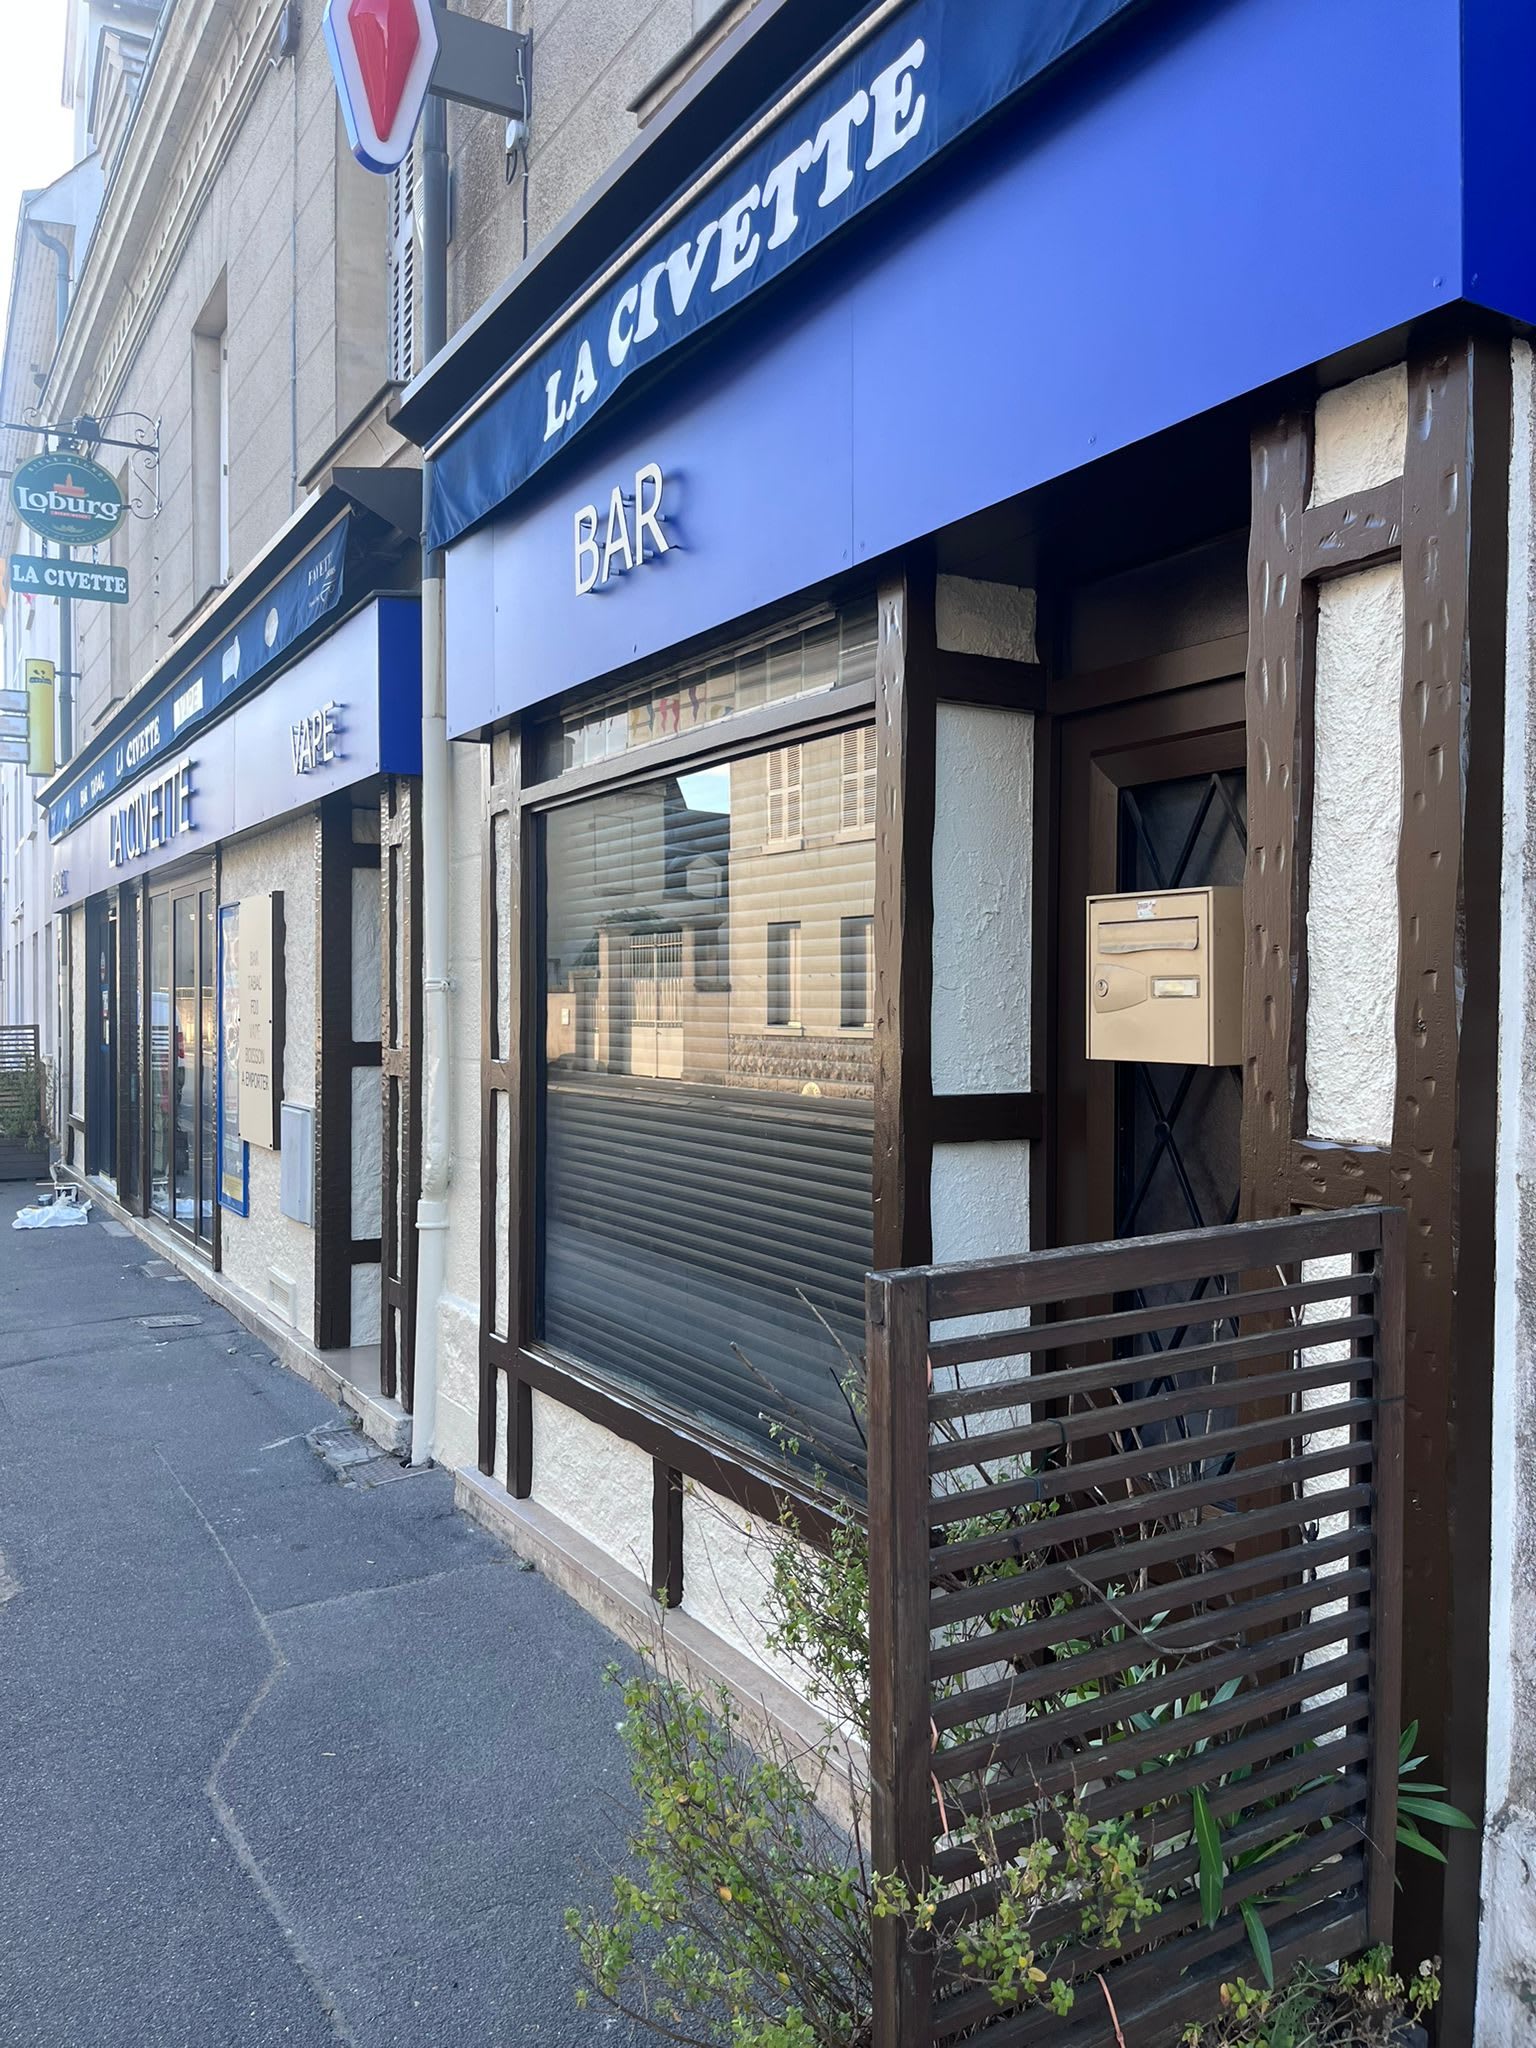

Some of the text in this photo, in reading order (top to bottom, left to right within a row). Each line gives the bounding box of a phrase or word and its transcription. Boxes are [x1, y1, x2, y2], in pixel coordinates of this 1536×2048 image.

[543, 38, 925, 442] LA CIVETTE
[16, 486, 120, 521] Loburg
[574, 462, 669, 597] BAR
[12, 564, 127, 594] LA CIVETTE
[116, 747, 124, 777] LA
[126, 715, 160, 768] CIVETTE
[290, 700, 335, 776] VAPE
[109, 757, 191, 869] LA CIVETTE
[248, 975, 262, 991] TABAC
[245, 1071, 270, 1090] EMPORTER
